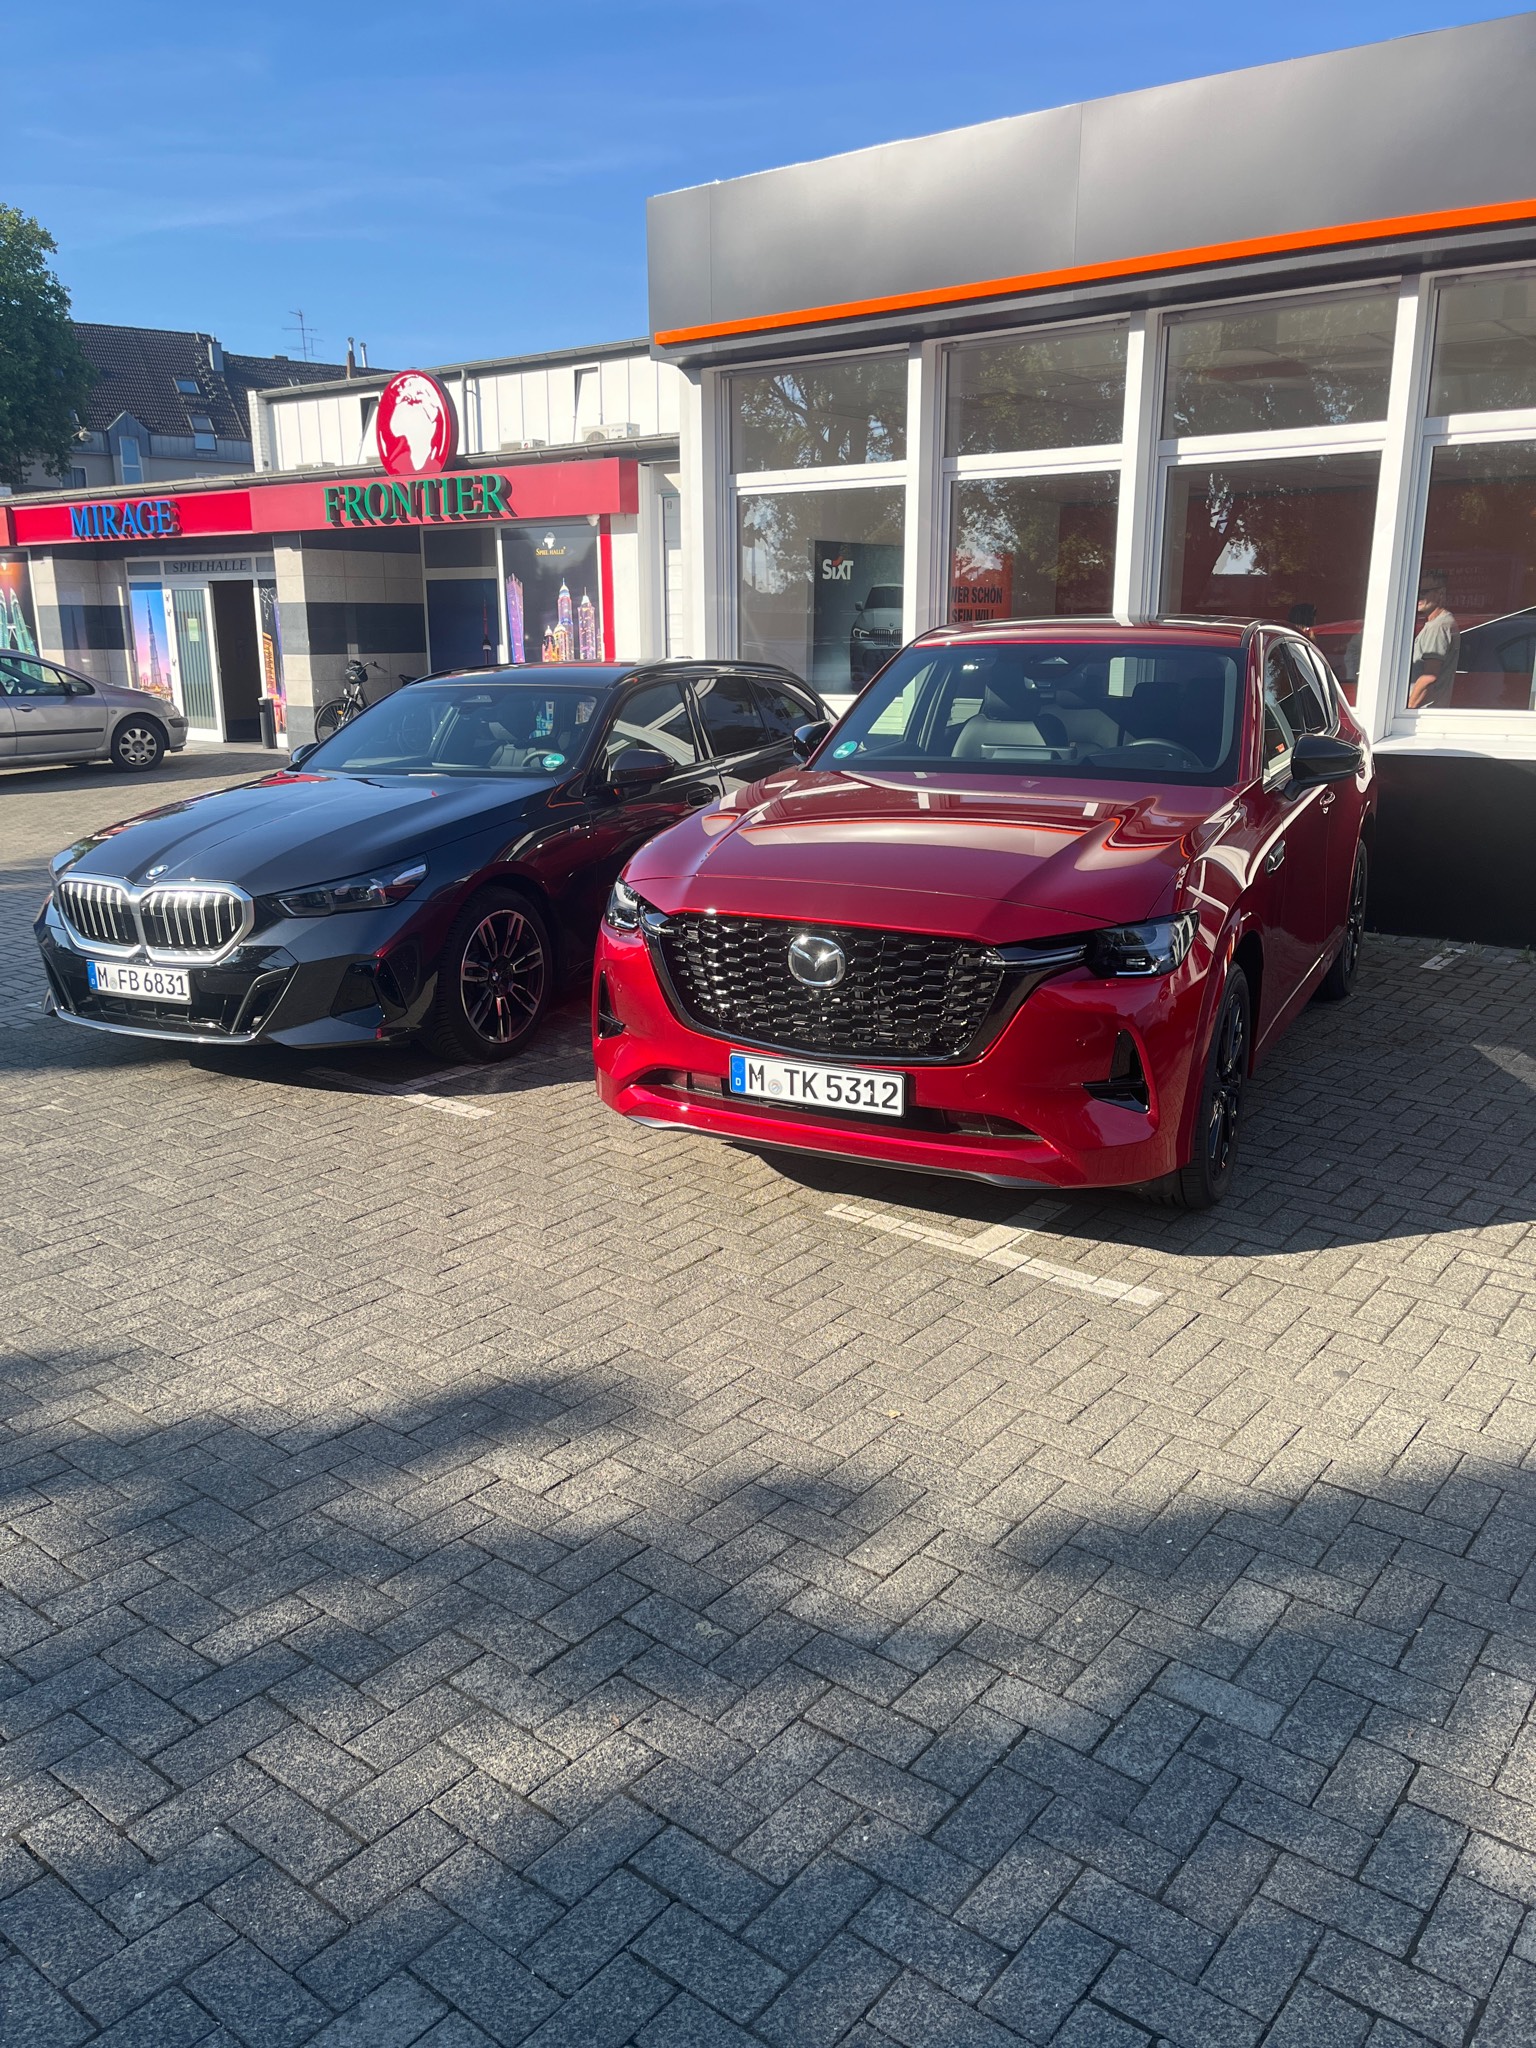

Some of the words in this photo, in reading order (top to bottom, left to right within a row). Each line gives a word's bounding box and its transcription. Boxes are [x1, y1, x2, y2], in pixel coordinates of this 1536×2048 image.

[323, 474, 507, 523] FRONTIER
[69, 500, 174, 538] MIRAGE
[172, 559, 247, 573] SPIELHALLE
[971, 583, 1003, 604] SCHÖN
[97, 966, 109, 988] M
[118, 969, 140, 991] FB
[144, 972, 188, 996] 6831
[748, 1063, 765, 1091] M
[784, 1068, 819, 1100] TK
[826, 1074, 899, 1110] 5312
